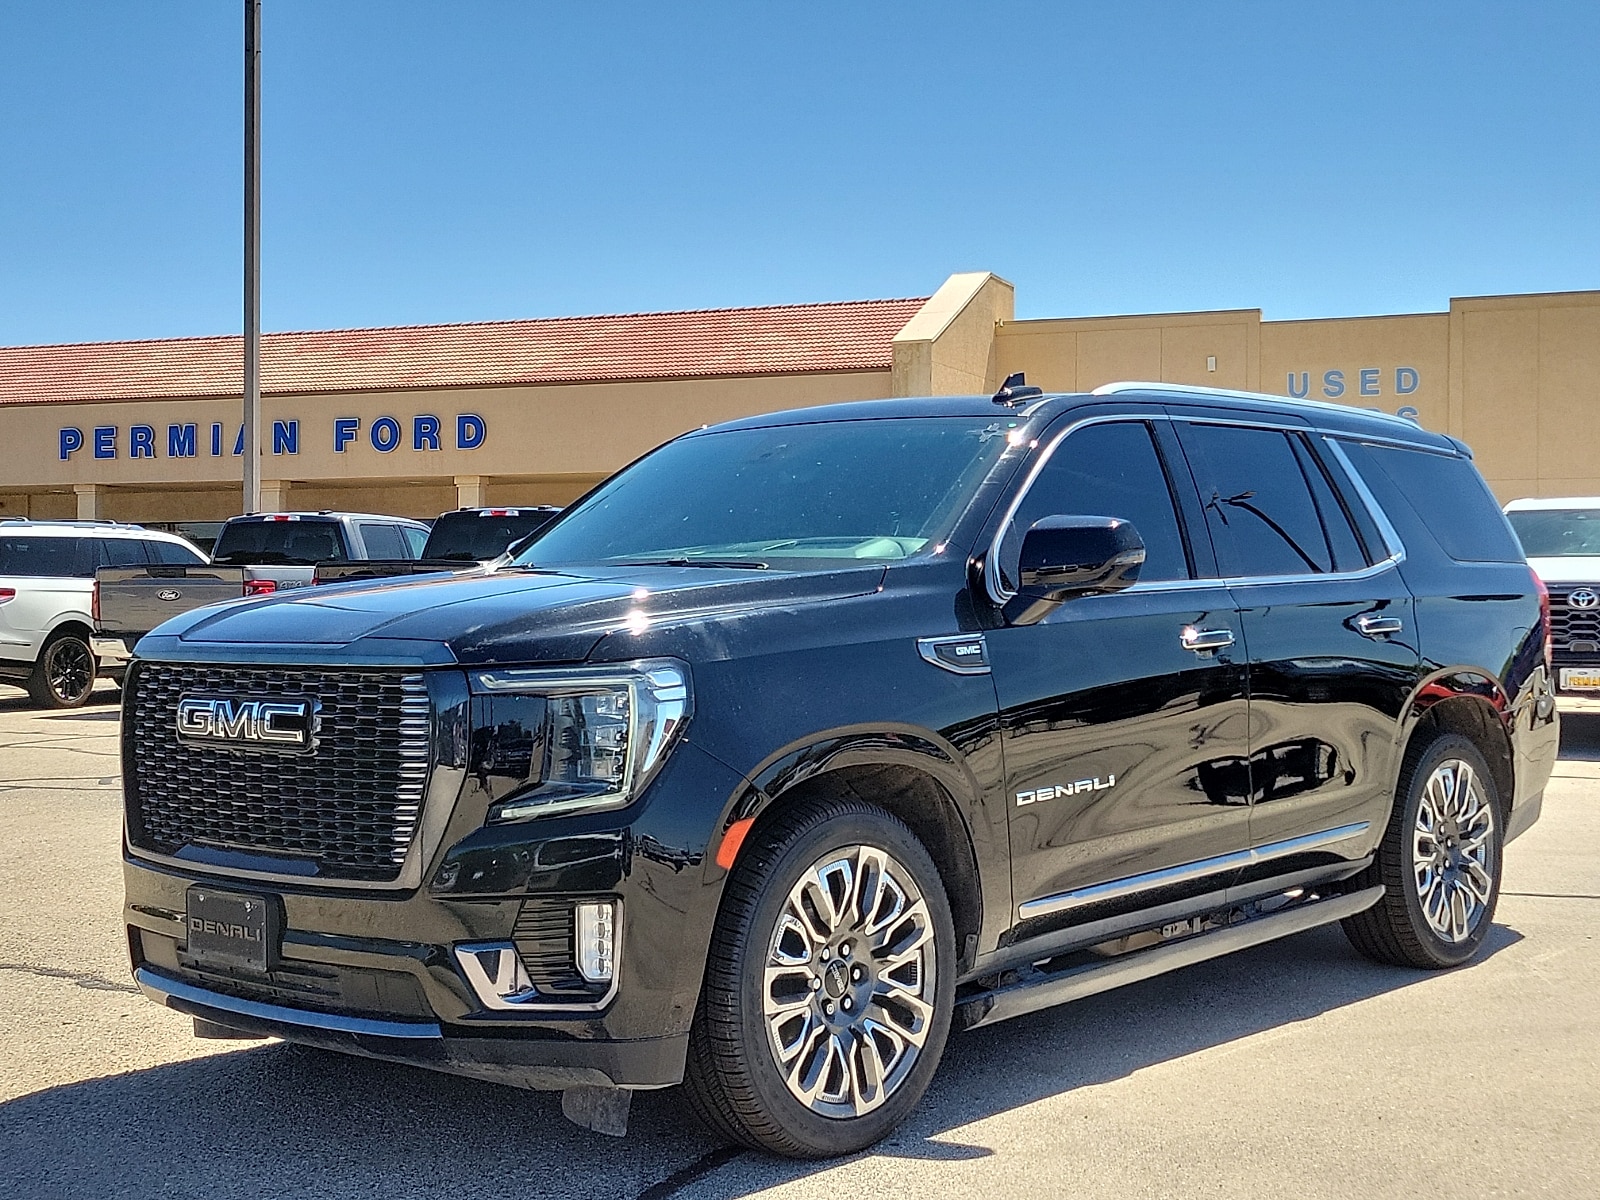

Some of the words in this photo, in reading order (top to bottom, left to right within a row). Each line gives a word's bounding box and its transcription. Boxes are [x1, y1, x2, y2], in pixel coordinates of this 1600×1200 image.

[1287, 367, 1419, 399] USED
[334, 413, 485, 453] FORD
[955, 645, 981, 656] GMC
[177, 699, 305, 742] GMC
[1016, 774, 1115, 806] DENALI
[190, 917, 261, 942] DENALI
